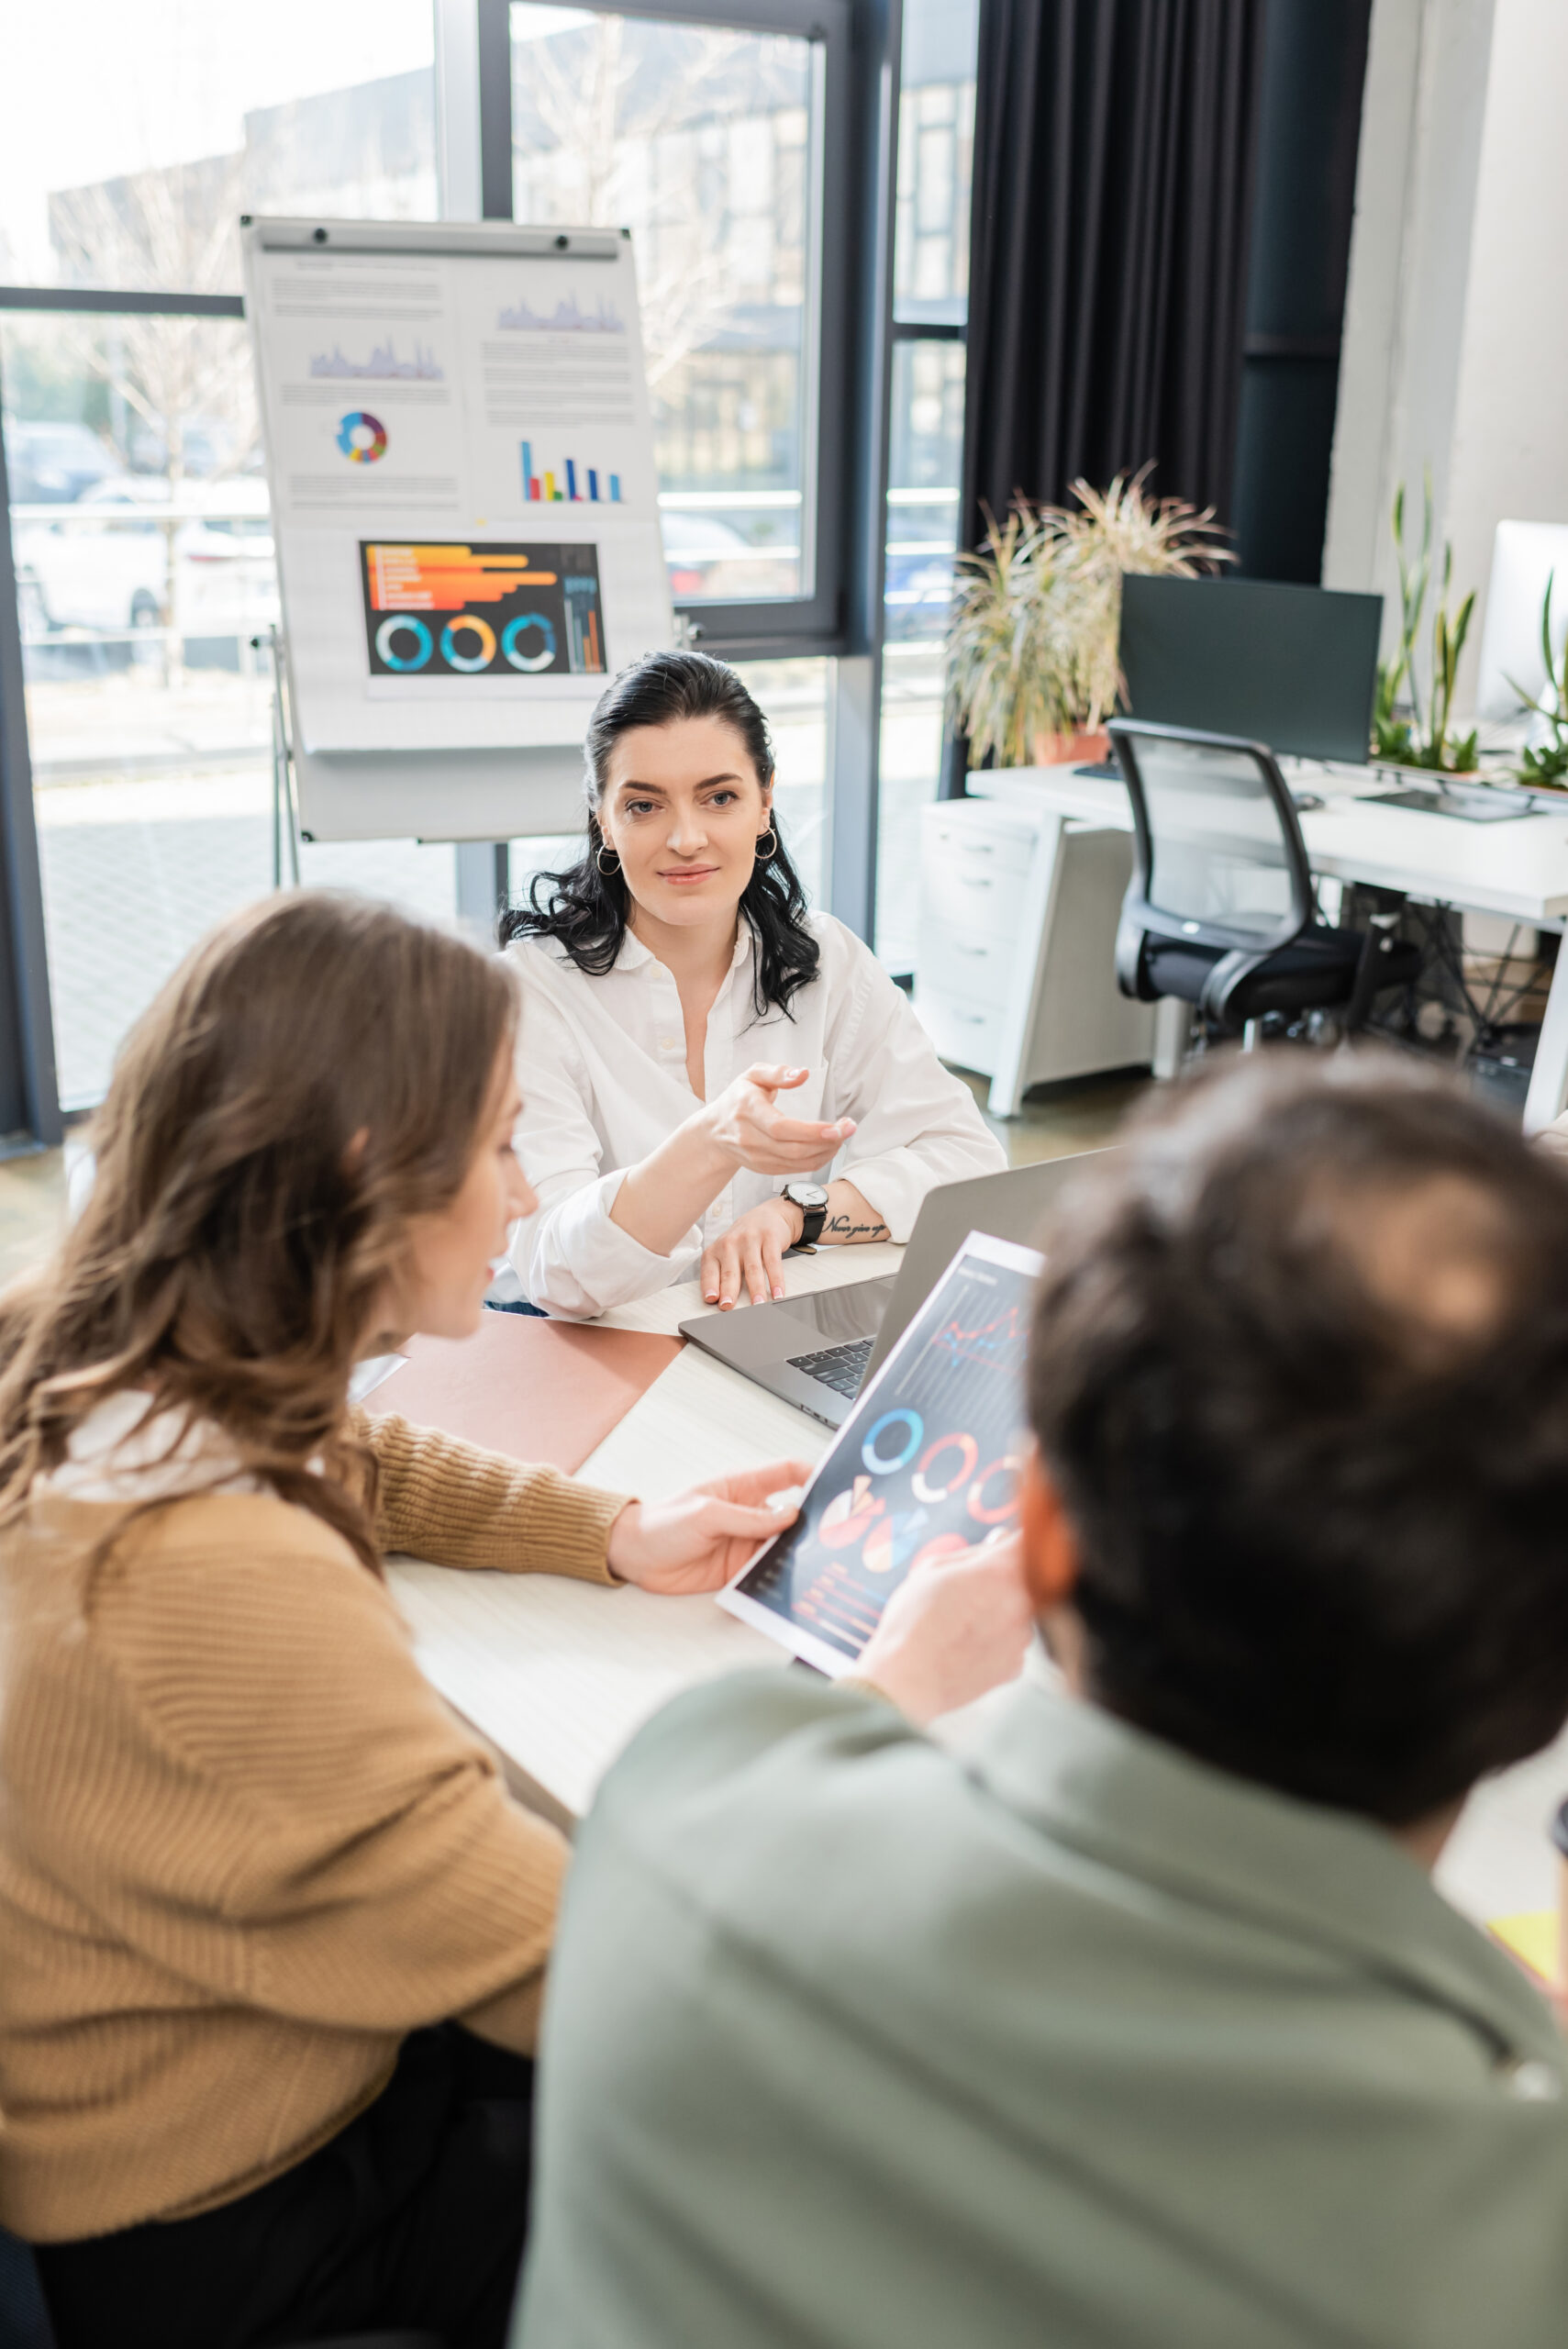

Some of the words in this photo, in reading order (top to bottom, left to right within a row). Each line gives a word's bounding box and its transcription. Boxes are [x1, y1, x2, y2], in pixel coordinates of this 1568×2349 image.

[821, 1215, 851, 1232] Never
[845, 1223, 871, 1239] give
[872, 1224, 886, 1239] up
